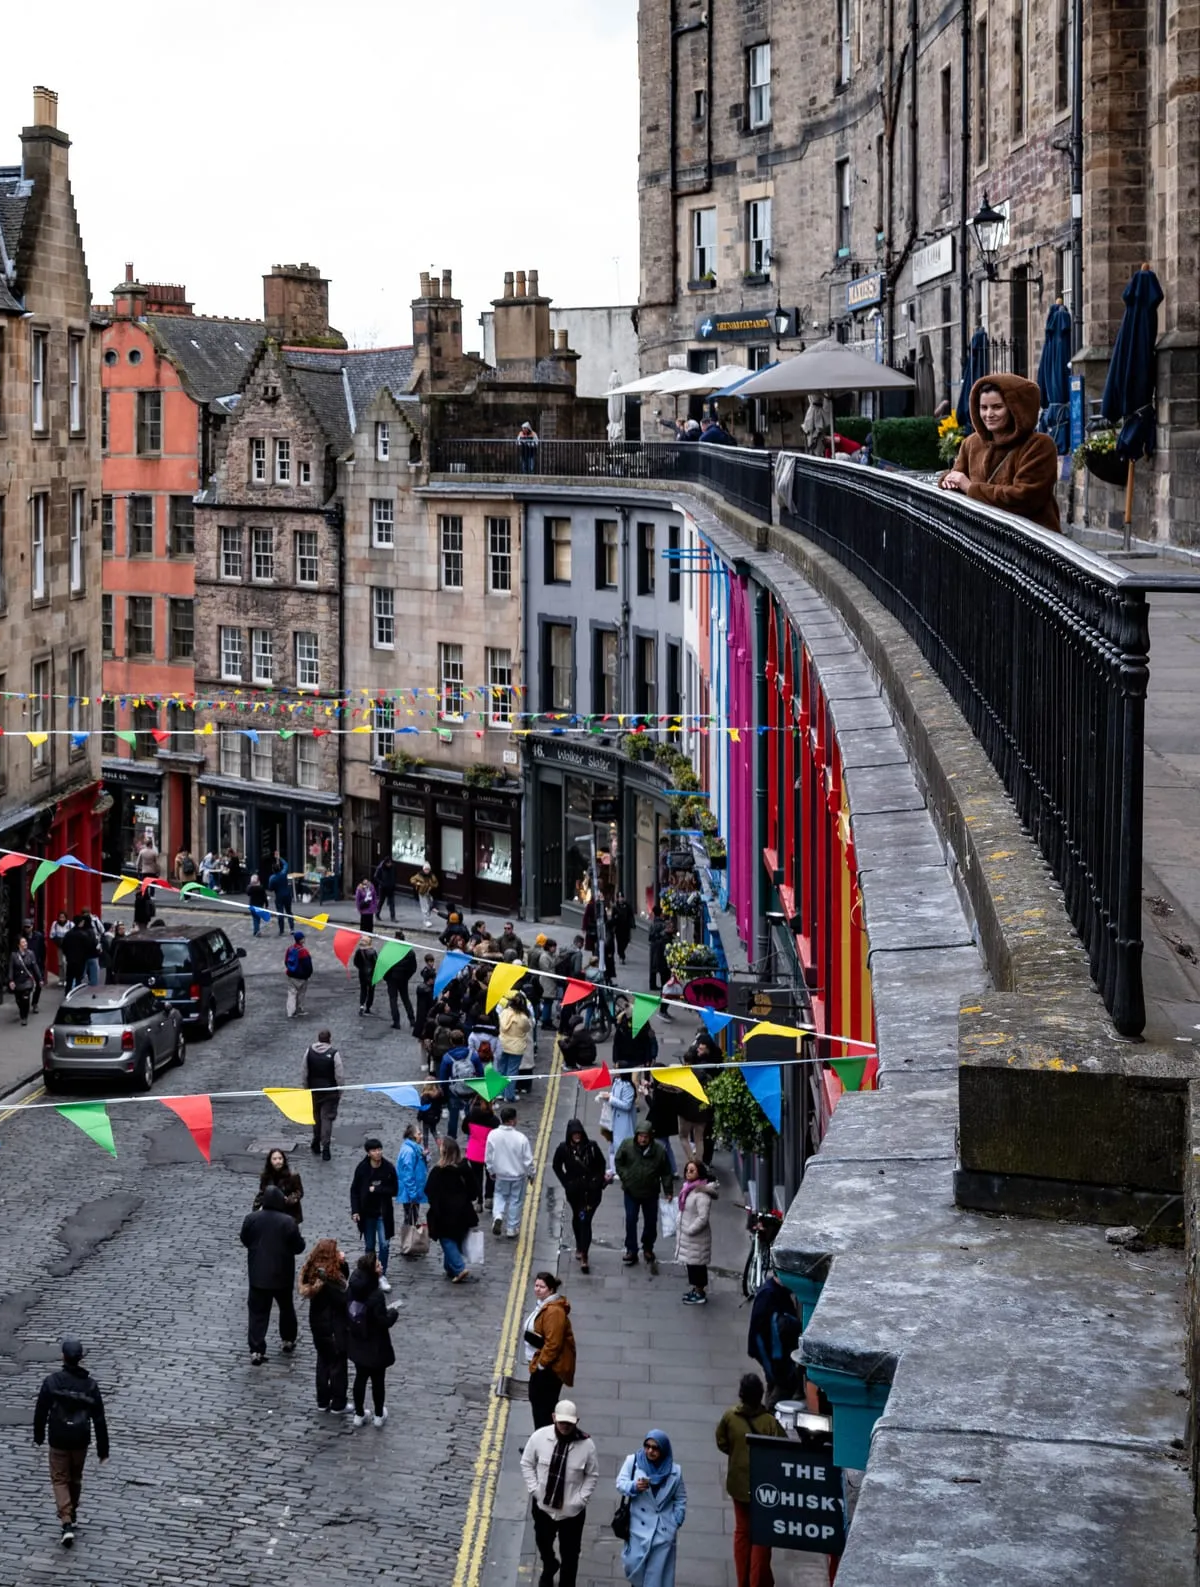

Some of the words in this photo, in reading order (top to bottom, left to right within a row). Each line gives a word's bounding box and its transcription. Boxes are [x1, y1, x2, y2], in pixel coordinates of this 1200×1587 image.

[557, 749, 584, 765] Walker
[588, 755, 610, 773] Slater
[781, 1462, 826, 1481] THE
[773, 1519, 835, 1540] SHOP
